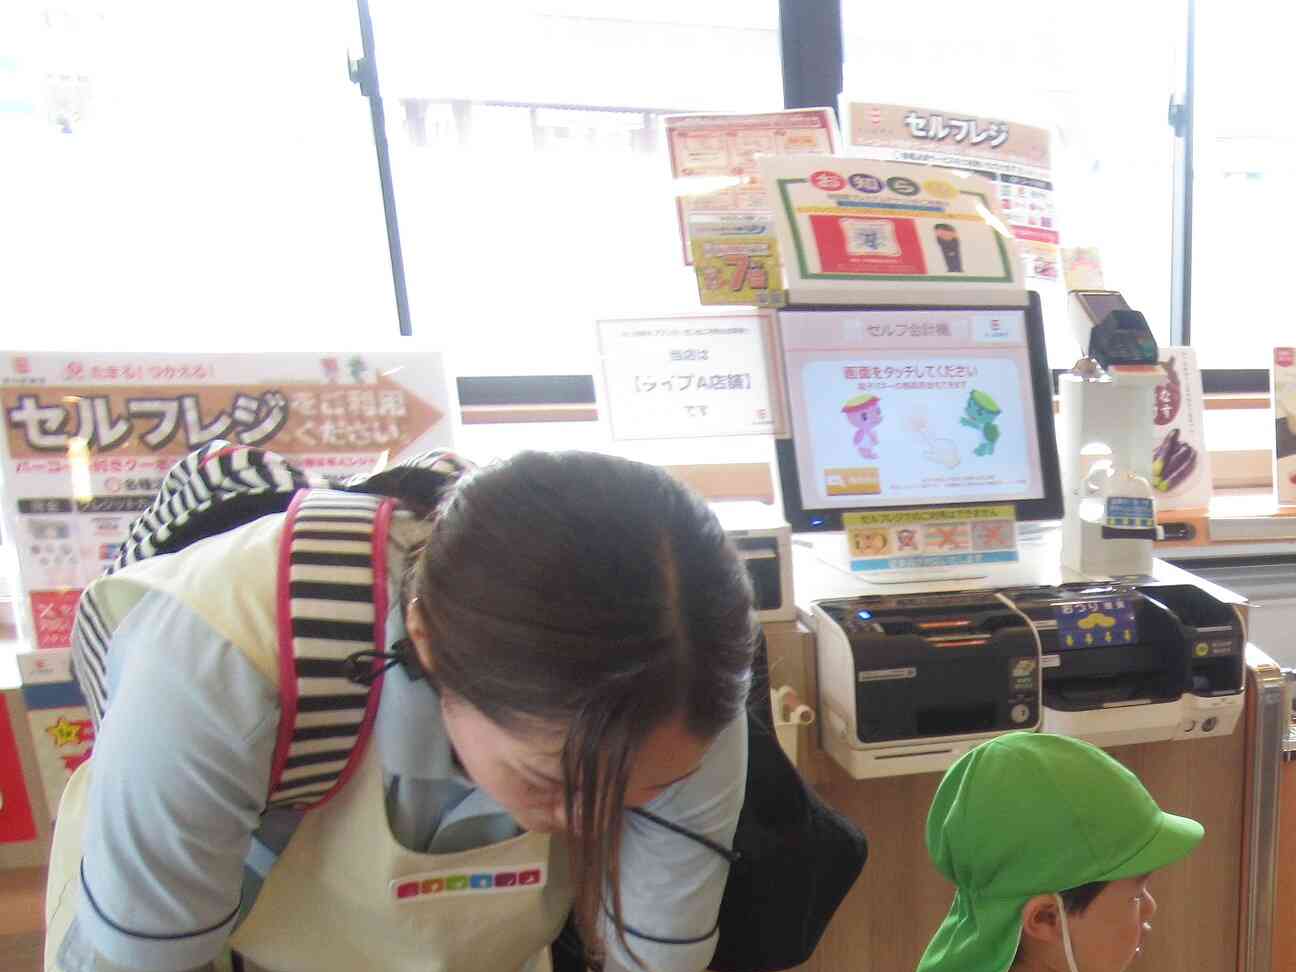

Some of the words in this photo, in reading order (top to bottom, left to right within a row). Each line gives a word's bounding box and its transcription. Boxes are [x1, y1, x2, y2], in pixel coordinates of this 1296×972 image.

[904, 110, 1010, 149] セルフレジ
[9, 390, 289, 451] セルフレジ
